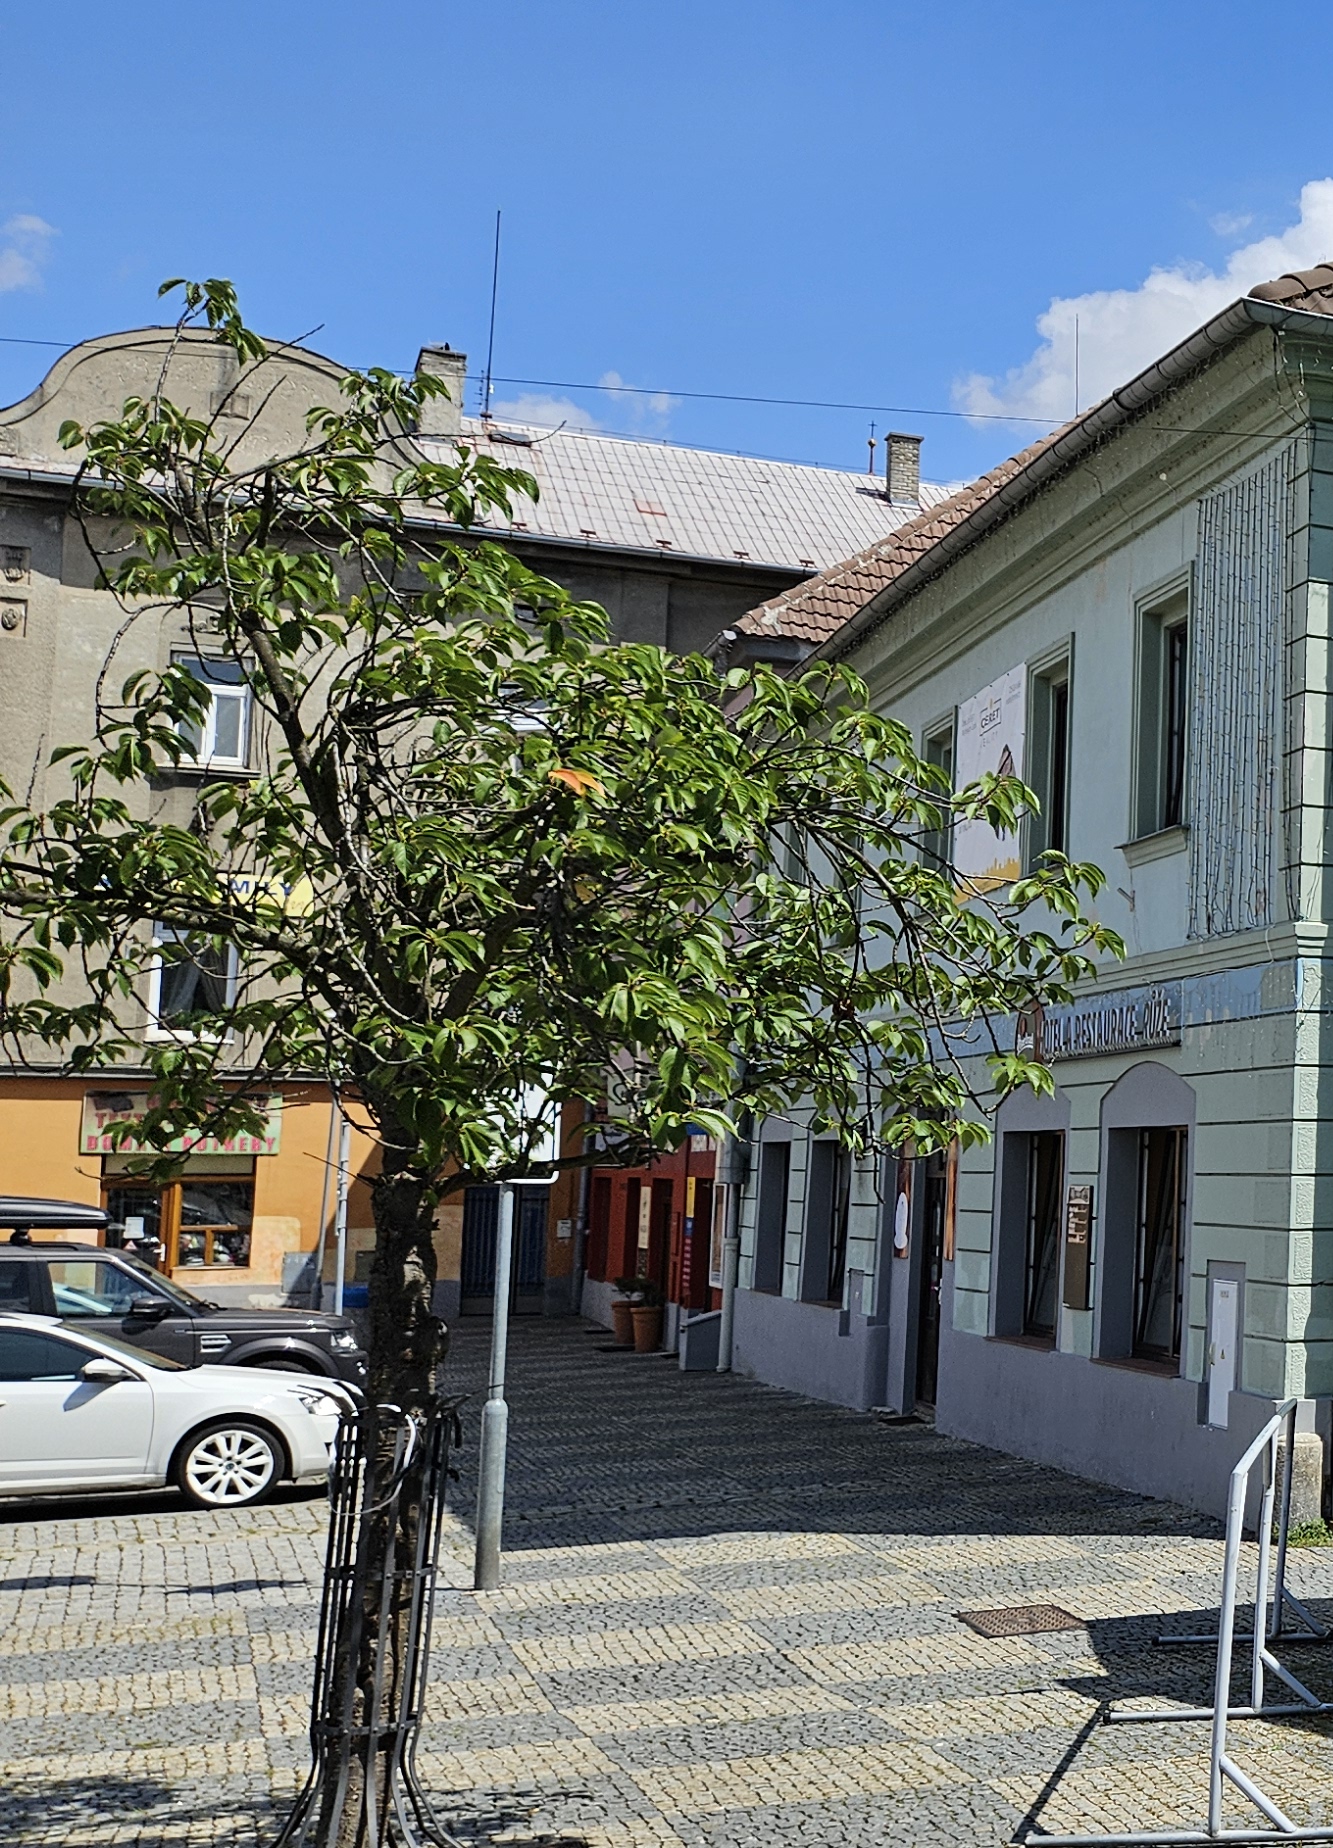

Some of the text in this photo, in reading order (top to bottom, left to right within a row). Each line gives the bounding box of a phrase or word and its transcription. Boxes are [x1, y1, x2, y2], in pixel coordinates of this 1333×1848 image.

[1040, 1018, 1065, 1056] HOTEL
[1075, 1004, 1138, 1049] RESTAURACE
[1143, 989, 1171, 1040] RŮŽE
